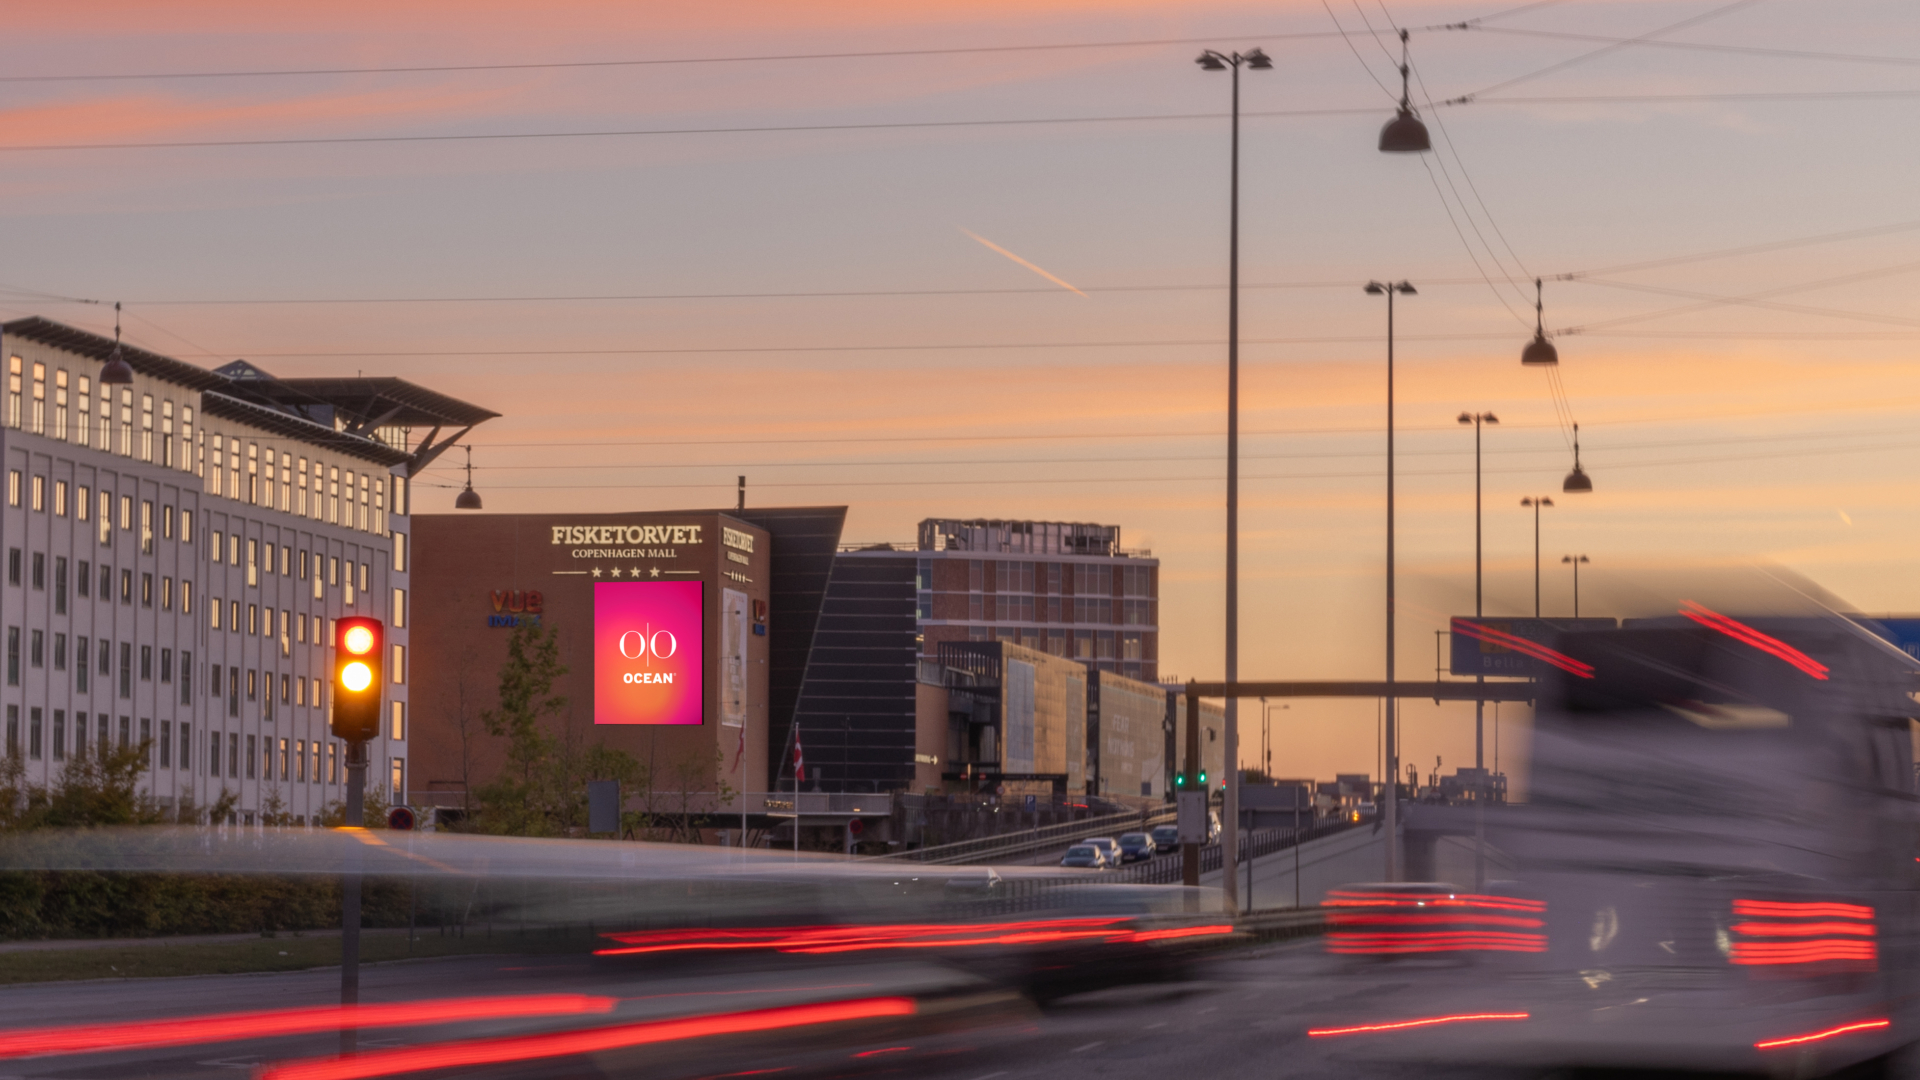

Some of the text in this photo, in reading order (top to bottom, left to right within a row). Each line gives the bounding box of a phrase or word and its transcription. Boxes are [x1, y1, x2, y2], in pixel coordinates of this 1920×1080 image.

[572, 549, 677, 559] COPENHAGEN MALL
[1483, 656, 1524, 668] Bella
